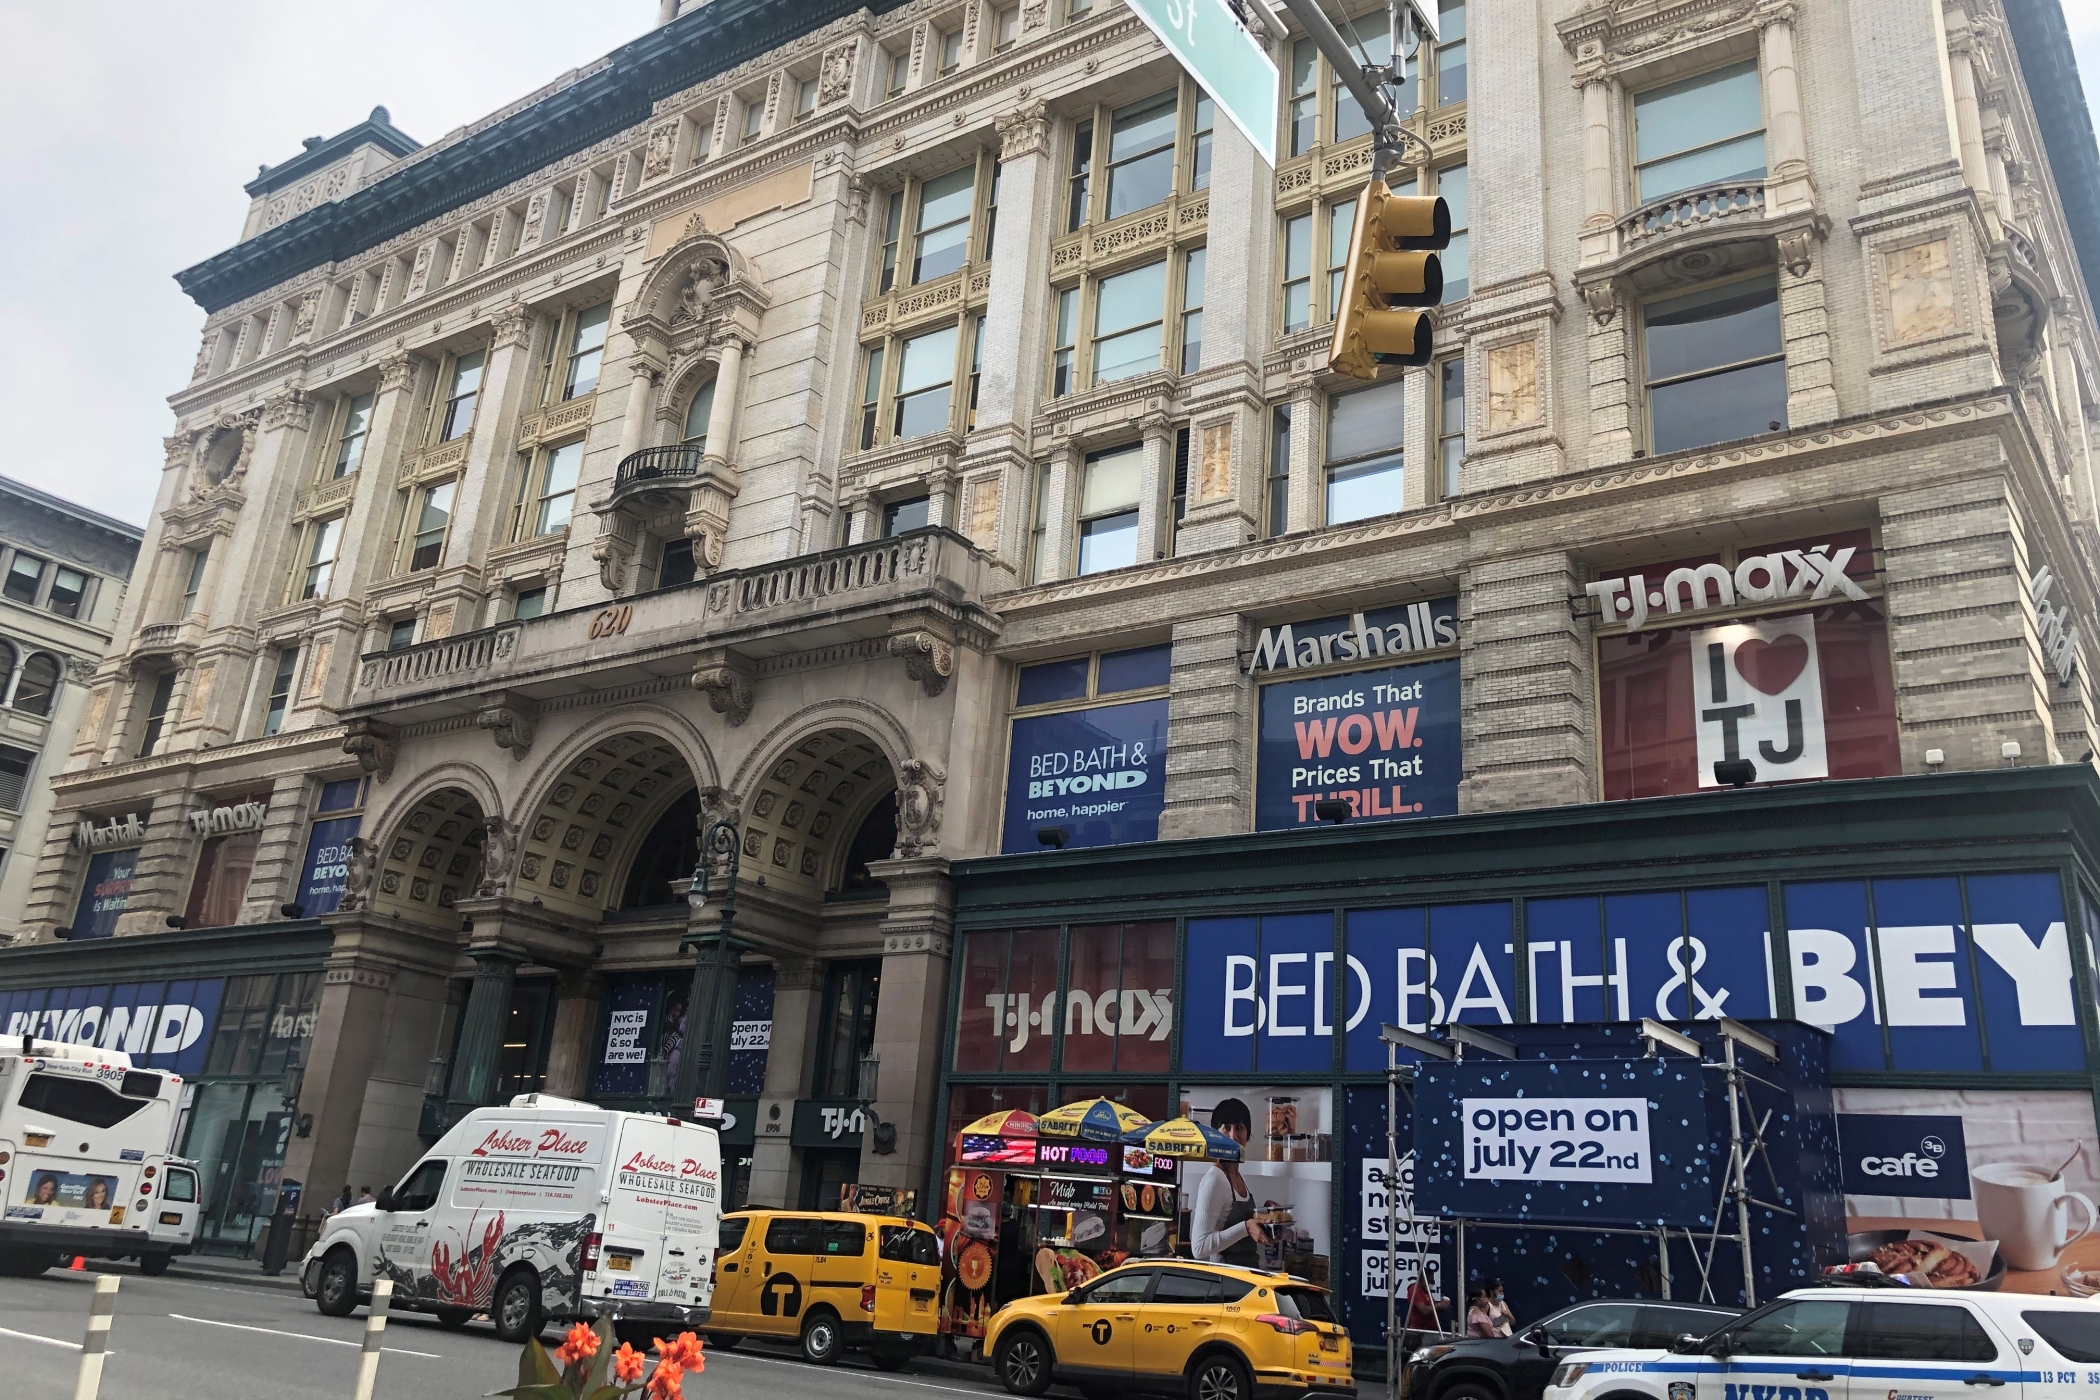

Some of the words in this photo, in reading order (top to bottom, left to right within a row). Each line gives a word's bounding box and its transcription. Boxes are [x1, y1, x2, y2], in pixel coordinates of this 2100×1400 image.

[588, 605, 633, 639] 620
[1249, 601, 1457, 675] Marshalls
[1294, 690, 1365, 715] Brands
[1372, 681, 1423, 704] That
[1294, 707, 1423, 760] WOW.
[1030, 752, 1068, 779] BED
[1073, 745, 1127, 773] BATH
[1131, 741, 1148, 765] &
[1292, 764, 1361, 788] Prices
[1369, 755, 1423, 780] That
[1028, 769, 1148, 799] BEYOND
[1027, 806, 1068, 820] home,
[1071, 800, 1126, 818] happier
[77, 813, 145, 848] Marshalls
[317, 846, 339, 866] BED
[113, 867, 132, 879] Your
[312, 864, 349, 880] BEYO
[94, 900, 102, 912] Is
[1224, 951, 1372, 1038] BED
[1397, 937, 1629, 1034] BATH
[1656, 936, 1730, 1020] &
[614, 1014, 633, 1024] NYC
[635, 1012, 644, 1023] is
[612, 1026, 637, 1037] open
[610, 1039, 618, 1048] &
[620, 1040, 632, 1048] so
[608, 1052, 625, 1060] are
[626, 1050, 643, 1061] we!
[71, 1065, 81, 1073] City
[96, 1067, 124, 1081] 3905
[765, 1123, 780, 1132] 1996
[1040, 1120, 1079, 1132] SABRETT
[1472, 1108, 1575, 1138] open
[1585, 1108, 1638, 1131] on
[471, 1128, 532, 1157] Lobster
[533, 1129, 588, 1158] Place
[1149, 1141, 1203, 1153] SABRETT
[1041, 1146, 1069, 1162] HOT
[1071, 1148, 1108, 1164] FOOD
[1154, 1157, 1173, 1170] FOOD
[1469, 1137, 1541, 1174] july
[1549, 1140, 1640, 1170] 22nd
[466, 1162, 528, 1178] WHOLESALE
[529, 1164, 580, 1182] SEAFOOD
[621, 1151, 676, 1173] Lobster
[680, 1158, 718, 1180] Place
[1861, 1152, 1939, 1177] cafe
[619, 1174, 675, 1192] WHOLESALE
[679, 1182, 716, 1199] SEAFOOD
[1050, 1181, 1076, 1198] Mido
[291, 1192, 297, 1201] P
[636, 1195, 698, 1211] LobsterPlace.com
[608, 1223, 615, 1231] 11
[1604, 1362, 1642, 1373] POLICE
[2043, 1371, 2053, 1383] 13
[2057, 1371, 2076, 1384] PCT
